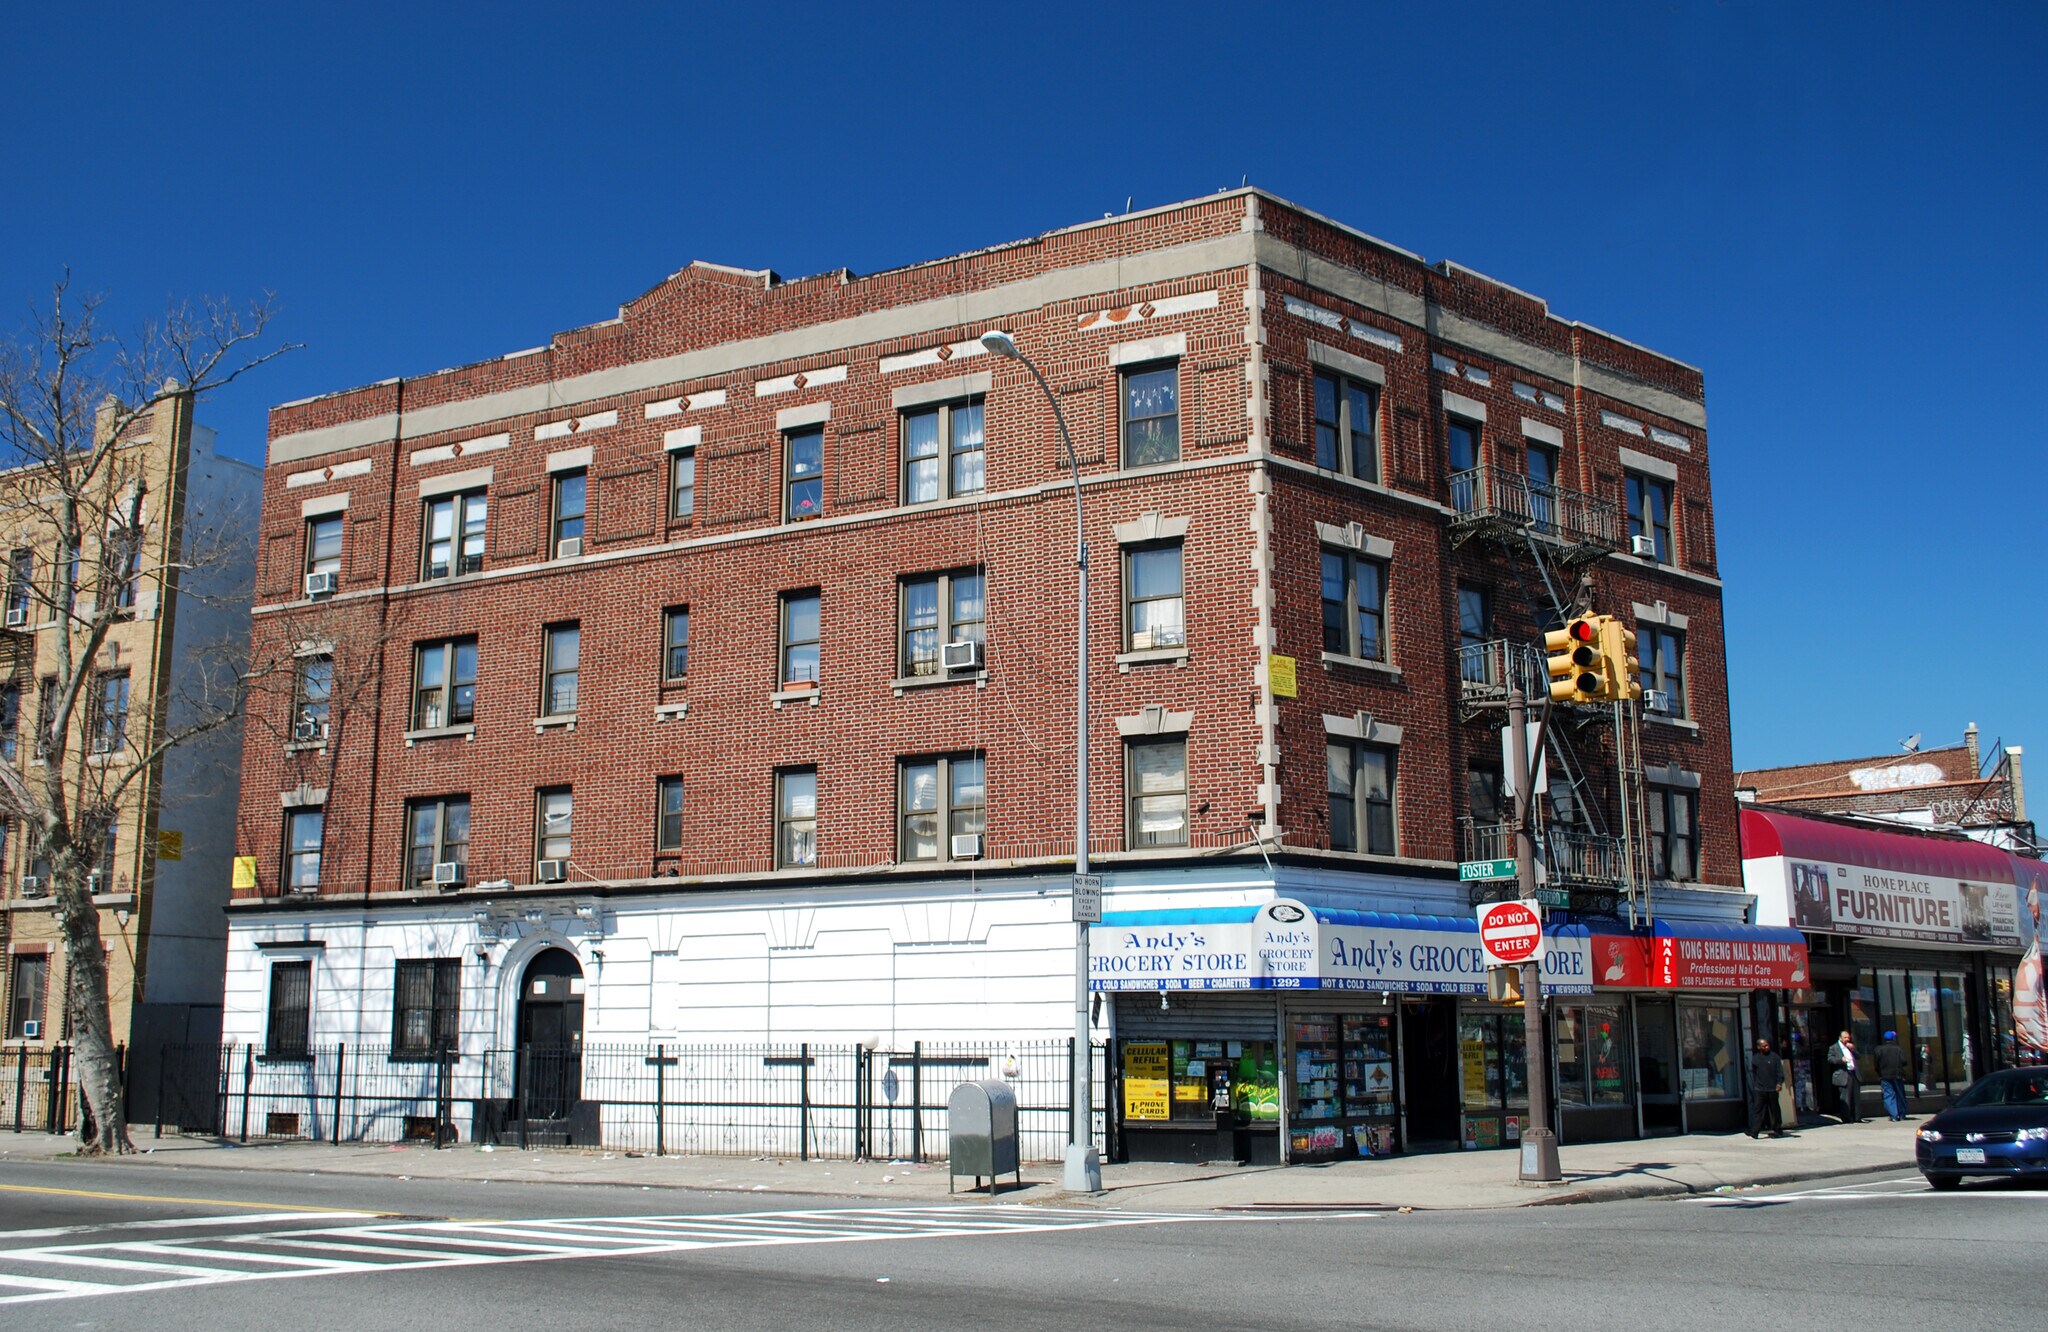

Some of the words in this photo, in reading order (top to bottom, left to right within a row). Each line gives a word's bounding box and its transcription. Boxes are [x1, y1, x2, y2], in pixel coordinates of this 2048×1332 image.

[1461, 862, 1494, 878] FOSTER
[1075, 888, 1099, 896] BLOWING
[1836, 888, 1951, 927] FURNITURE
[1489, 915, 1504, 926] DO
[1508, 912, 1529, 924] NOT
[1992, 917, 2015, 925] FINANCING
[1123, 932, 1205, 951] Andy's
[1264, 931, 1310, 946] Andy's
[1494, 939, 1531, 952] ENTER
[1680, 940, 1702, 960] YONG
[1704, 942, 1730, 960] SHENG
[1733, 943, 1751, 961] NAIL
[1753, 943, 1776, 962] SALON
[1778, 945, 1794, 962] INC.
[1258, 949, 1314, 959] GROCERY
[1330, 937, 1403, 975] Andy's
[1410, 944, 1488, 973] GROCE
[1538, 951, 1583, 976] ORE
[1182, 953, 1247, 971] STORE
[1268, 961, 1306, 972] STORE
[1662, 939, 1672, 984] NAILS
[1690, 963, 1737, 975] Professional
[1739, 964, 1753, 975] Nail
[1755, 965, 1771, 975] Care
[1102, 979, 1119, 989] COLD
[1120, 979, 1159, 990] SANDWICHES
[1165, 979, 1182, 989] SODA
[1188, 979, 1205, 988] BEER
[1211, 978, 1251, 988] CIGARETTES
[1272, 978, 1300, 987] 1292
[1321, 978, 1336, 988] HOT
[1339, 978, 1344, 989] &
[1346, 979, 1365, 990] COLD
[1366, 980, 1409, 991] SANDWICHES
[1416, 982, 1434, 992] SODA
[1440, 983, 1458, 993] COLD
[1460, 983, 1475, 993] BEER
[1681, 977, 1694, 986] 1288
[1695, 977, 1724, 986] FLATBUSH
[1555, 985, 1592, 994] NEWSPAPERS
[1127, 1047, 1167, 1056] CELLULAR
[1133, 1055, 1161, 1064] REFILL
